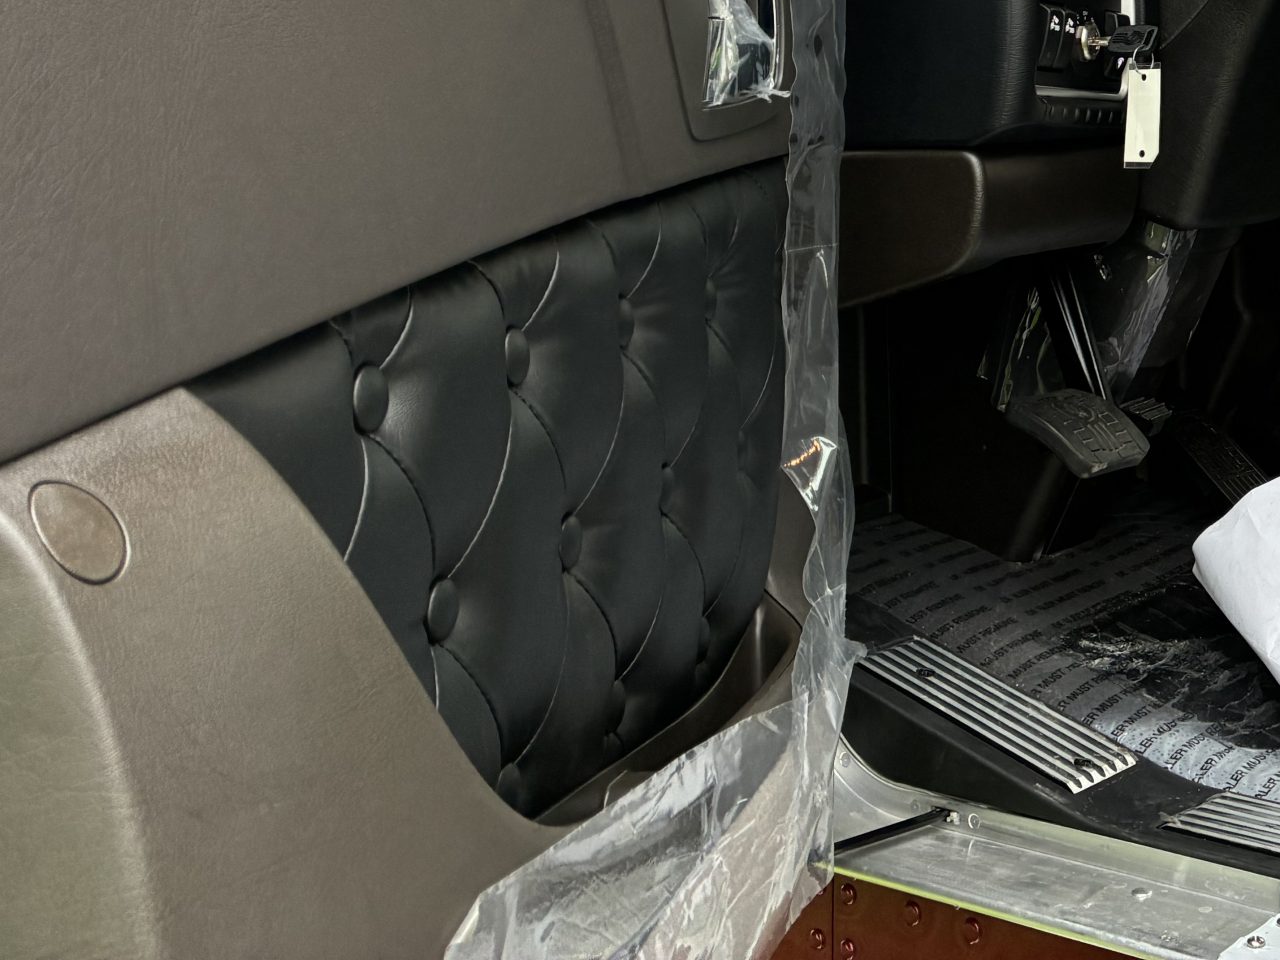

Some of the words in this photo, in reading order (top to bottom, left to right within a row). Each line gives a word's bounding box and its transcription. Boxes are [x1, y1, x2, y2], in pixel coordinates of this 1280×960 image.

[1066, 681, 1094, 701] MUST
[1099, 693, 1123, 714] MUST
[1126, 705, 1152, 727] MUST
[1223, 769, 1248, 792] ALER
[1255, 777, 1280, 799] ALER
